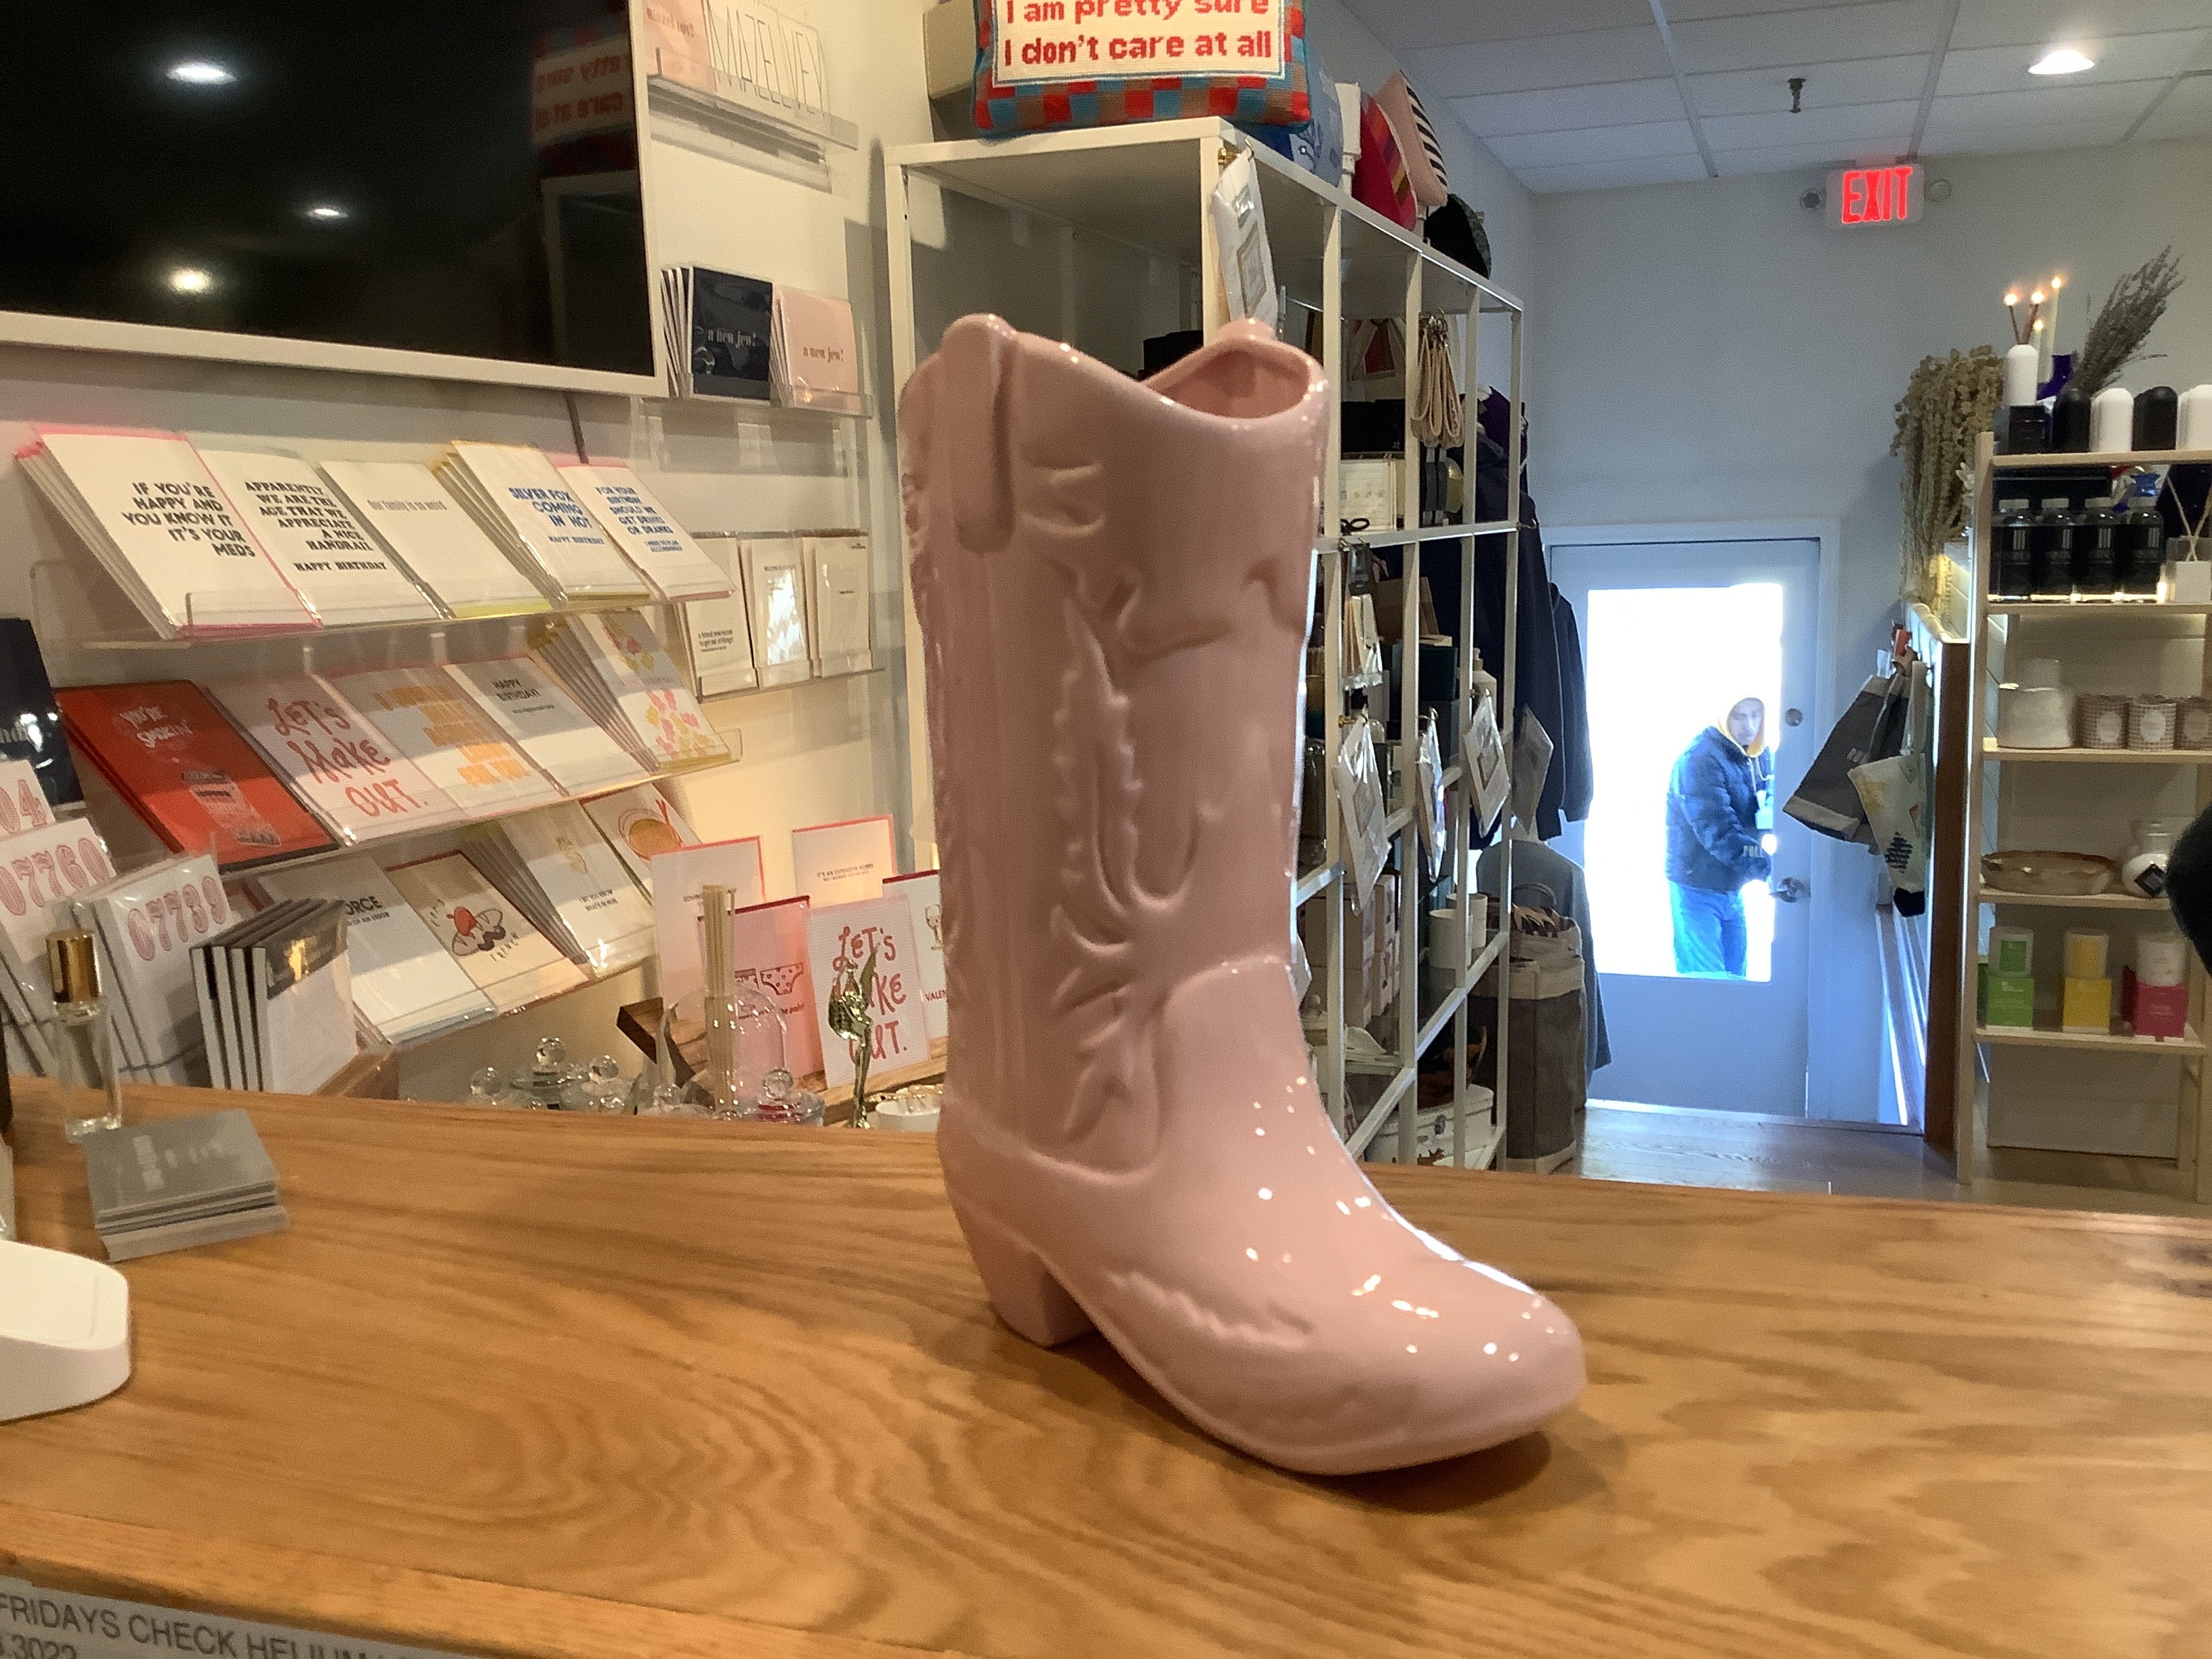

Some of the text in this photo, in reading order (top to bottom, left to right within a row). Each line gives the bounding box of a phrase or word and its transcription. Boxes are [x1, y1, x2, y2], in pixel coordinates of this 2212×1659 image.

[1007, 0, 1269, 24] I am pretty sure
[1004, 30, 1272, 66] I don't care at all
[1841, 166, 1913, 224] EXIT
[132, 482, 216, 498] IF YOU'RE
[245, 482, 324, 495] APPARENTLY
[508, 487, 575, 502] SILVER FOX
[132, 497, 224, 512] HAPPY AND
[255, 494, 338, 508] WE ARE THE
[532, 501, 583, 515] COMING
[259, 506, 348, 519] AGE THAT WE
[609, 506, 642, 515] SHOULD
[121, 512, 233, 527] YOU KNOW IT
[277, 518, 356, 531] APPRECIATE
[549, 515, 593, 529] IN HOT
[619, 516, 636, 525] GET
[168, 527, 245, 542] IT'S YOUR
[321, 529, 365, 541] A NICE
[627, 526, 642, 535] OR
[211, 543, 255, 556] MEDS
[305, 541, 374, 552] HANDRAIL
[293, 561, 387, 571] HAPPY BIRTHDAY
[491, 678, 521, 690] HAPPY
[128, 1614, 237, 1659] CHECK
[246, 1633, 367, 1659] HEL
